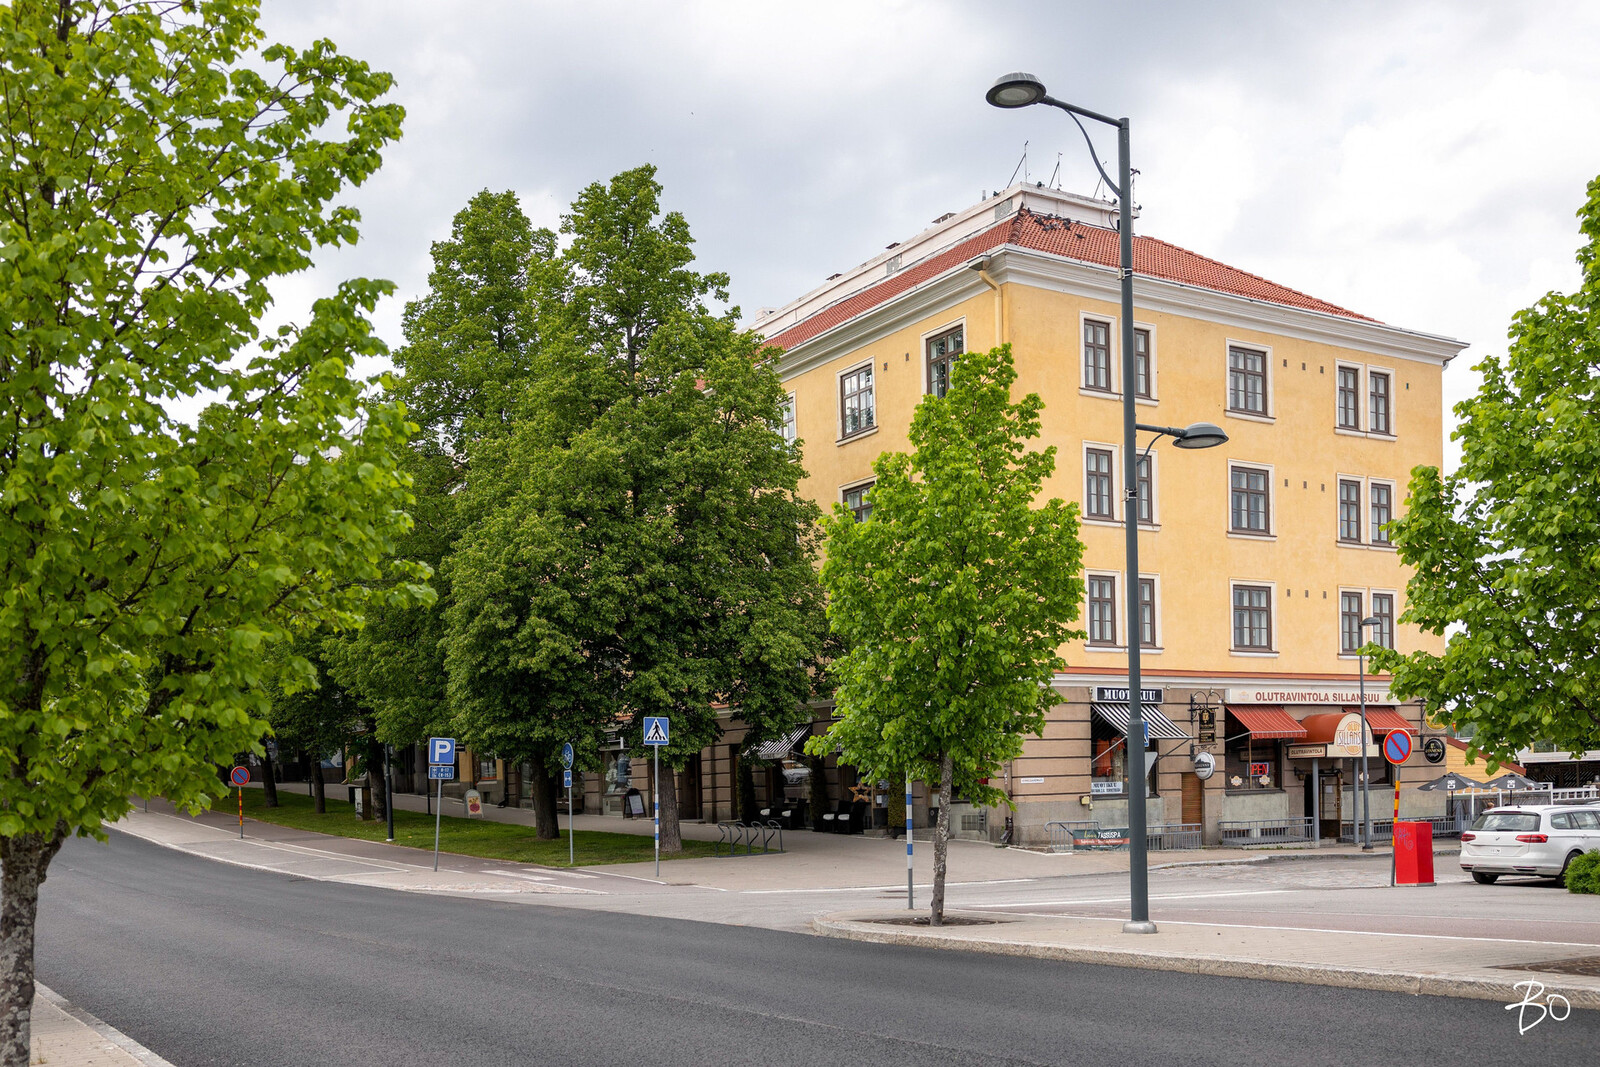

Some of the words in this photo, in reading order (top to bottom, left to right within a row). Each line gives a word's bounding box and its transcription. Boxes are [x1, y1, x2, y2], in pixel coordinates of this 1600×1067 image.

[1103, 689, 1156, 701] MUOTUU
[1255, 691, 1329, 702] OLUTRAVINTOLA
[1332, 692, 1380, 703] SILLANSUU
[435, 740, 451, 762] P
